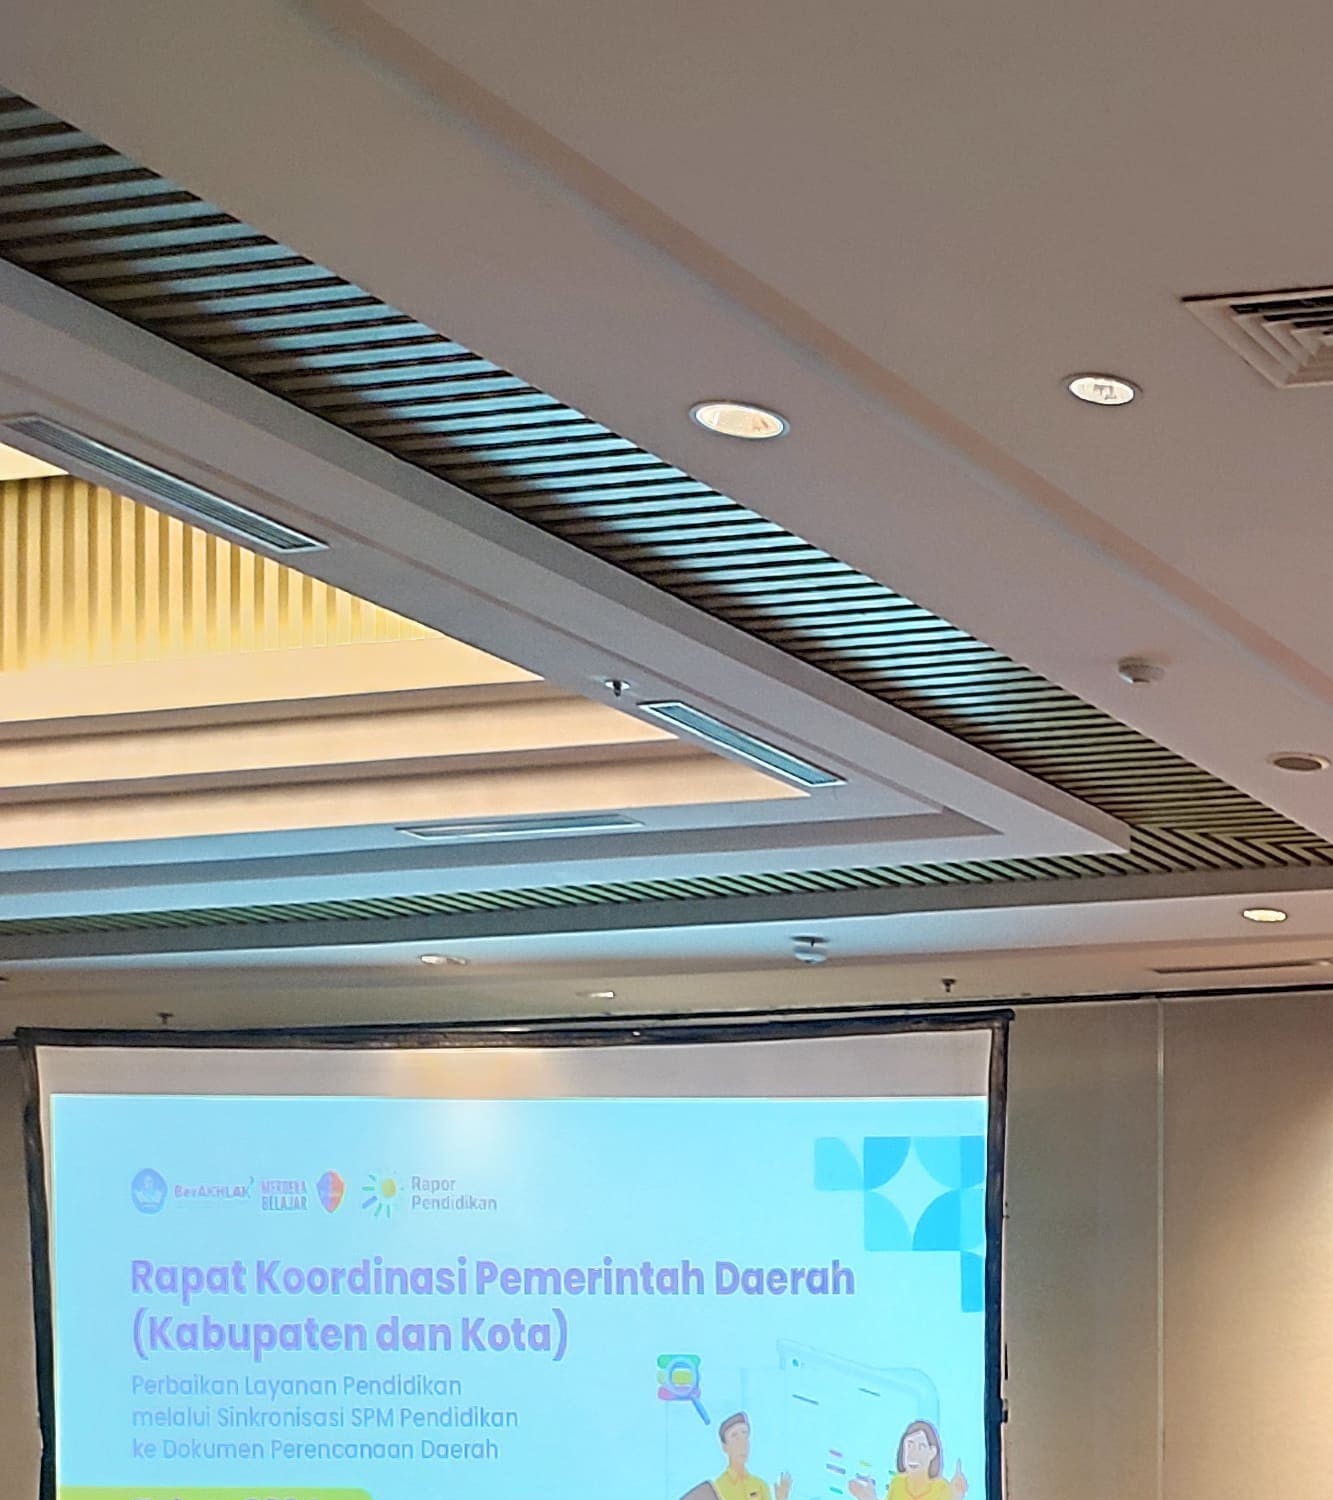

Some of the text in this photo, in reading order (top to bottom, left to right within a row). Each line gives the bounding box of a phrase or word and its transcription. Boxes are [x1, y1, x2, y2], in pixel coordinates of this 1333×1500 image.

[173, 1182, 252, 1200] BerAKHLAK
[260, 1179, 308, 1195] MERDEKA
[410, 1175, 457, 1195] Rapor
[261, 1195, 308, 1212] BELAJAR
[410, 1194, 498, 1211] Pendidikan
[131, 1256, 856, 1306] Rapat Koordinasi Pemerintah Daerah
[132, 1306, 569, 1364] (Kabupaten dan Kota)
[131, 1374, 463, 1401] Perbaikan Layanan Pendidikan
[131, 1406, 519, 1428] melalui Sinkronisasi SPM Pendidikan
[131, 1438, 499, 1460] ke Dokumen Perencanaan Daerah
